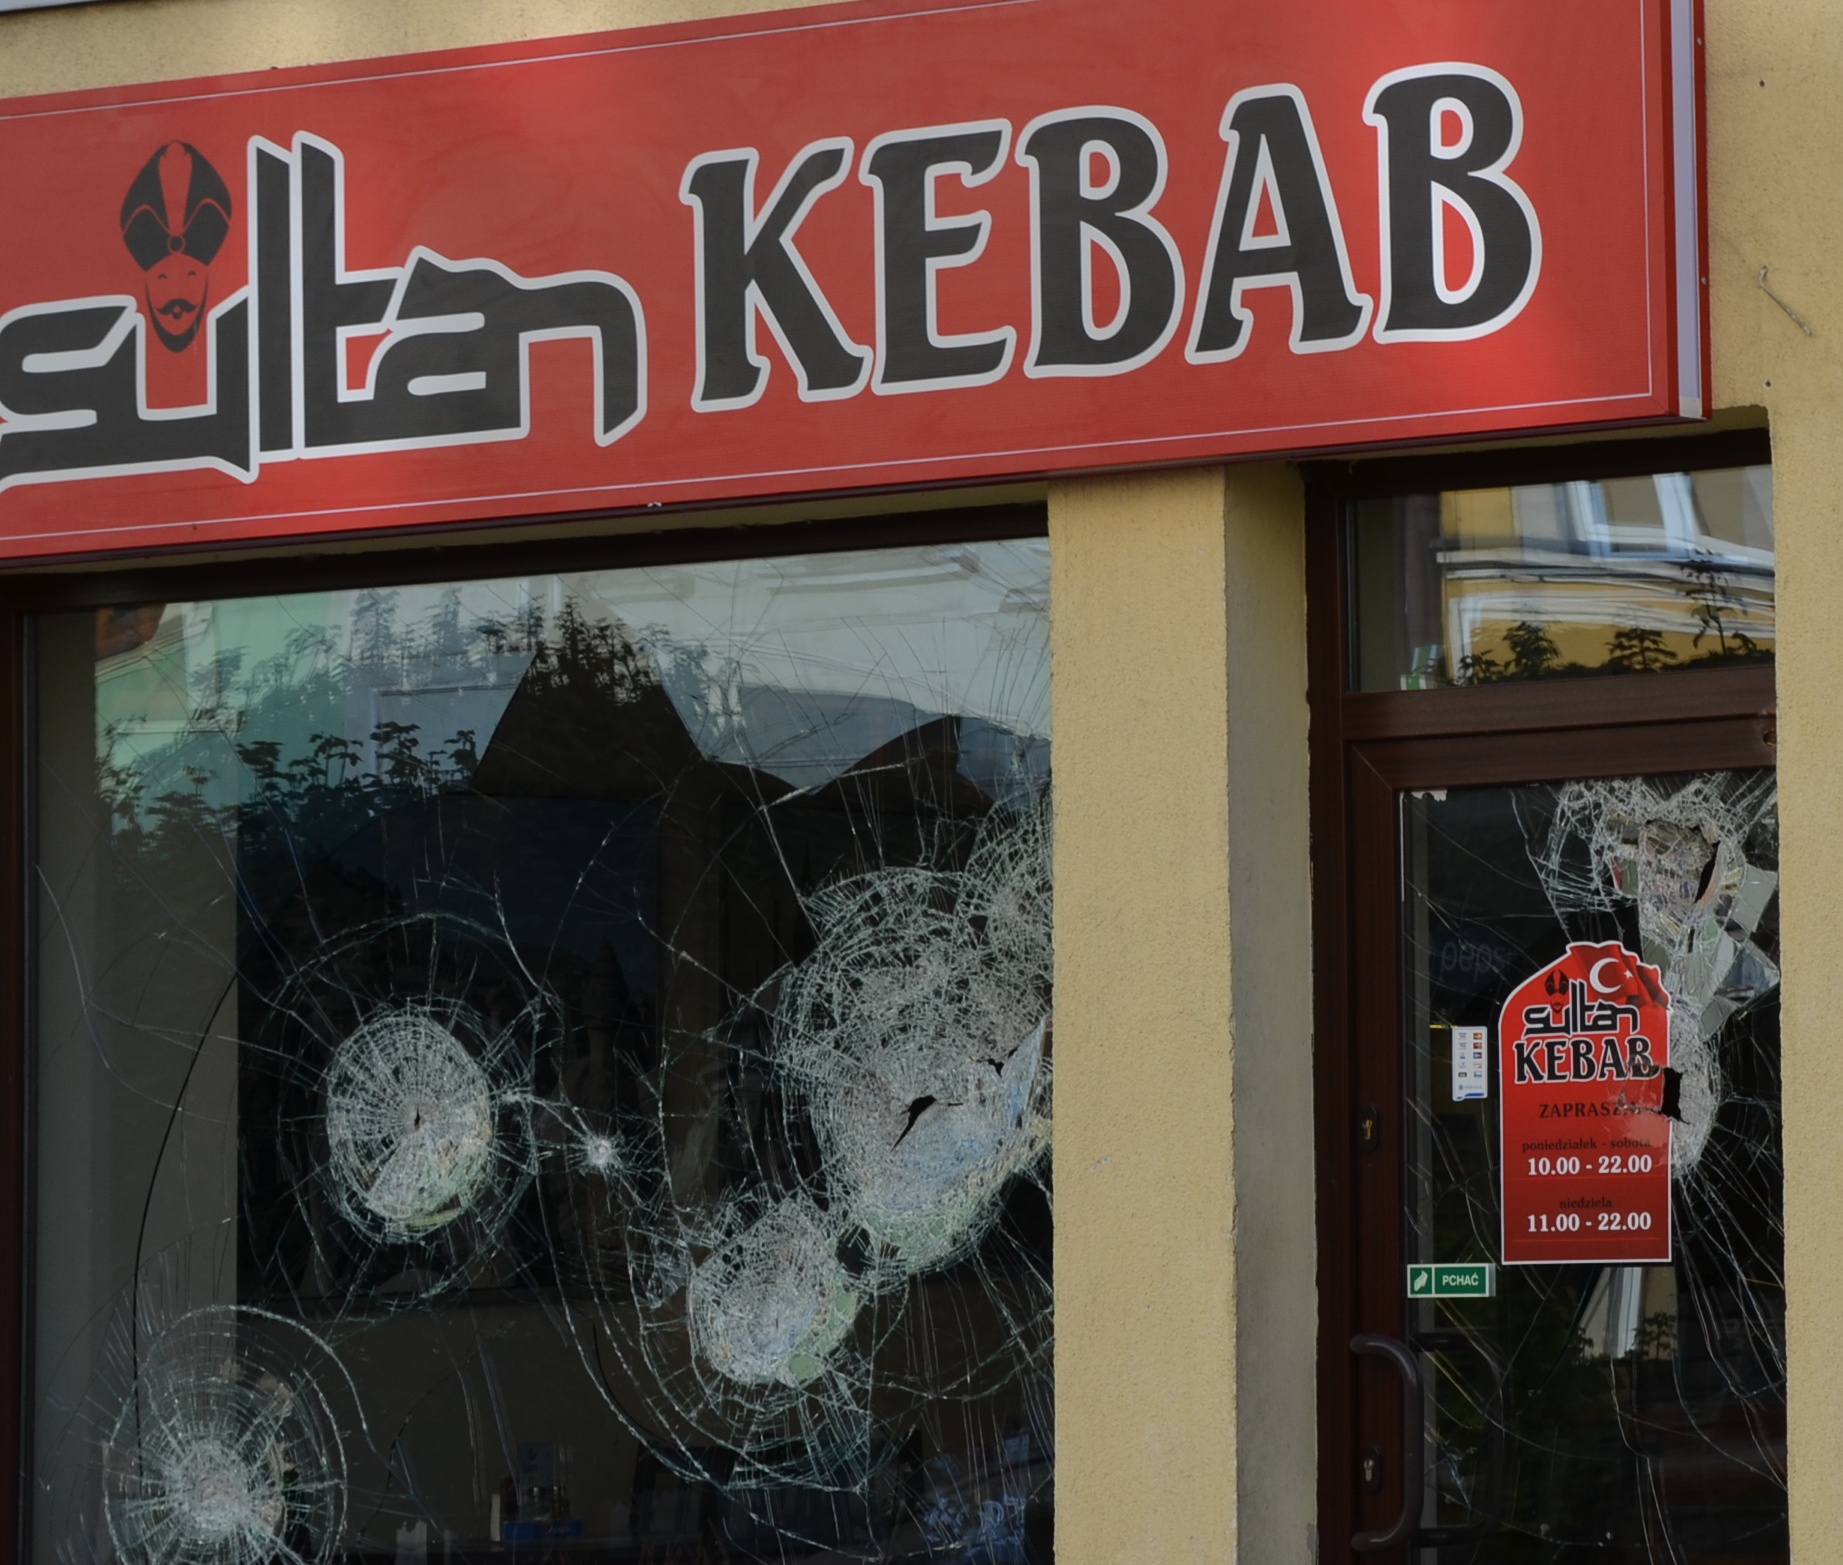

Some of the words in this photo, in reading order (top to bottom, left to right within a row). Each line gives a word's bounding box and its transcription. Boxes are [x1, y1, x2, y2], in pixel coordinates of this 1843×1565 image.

[679, 61, 1543, 413] KEBAB
[1512, 1035, 1662, 1085] KEBAB
[1609, 1136, 1652, 1149] sobota
[1527, 1156, 1581, 1176] 10.00
[1598, 1154, 1653, 1174] 22.00
[1559, 1196, 1613, 1210] niedziela
[1527, 1213, 1581, 1233] 11.00
[1597, 1211, 1652, 1231] 22.00
[1442, 1272, 1479, 1287] PCHAĆ
